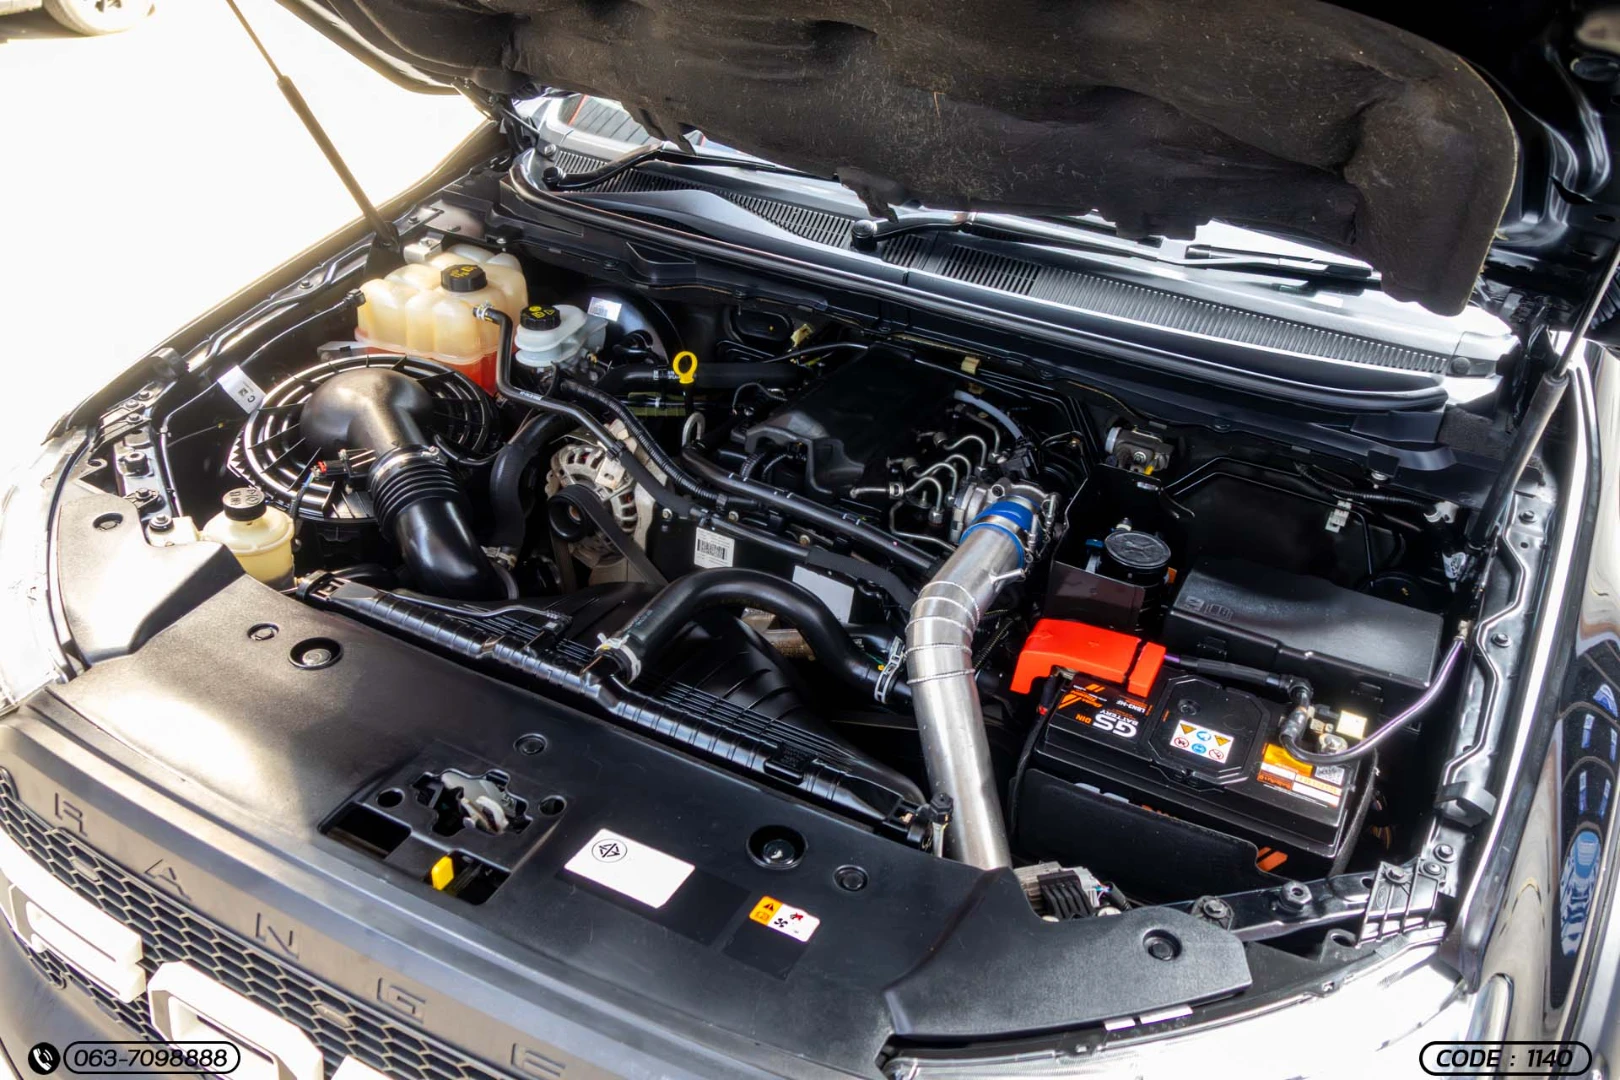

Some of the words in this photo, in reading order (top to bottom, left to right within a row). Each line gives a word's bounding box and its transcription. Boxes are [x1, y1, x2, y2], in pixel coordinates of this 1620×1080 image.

[1075, 714, 1092, 724] DIN
[1092, 713, 1138, 738] GS
[1100, 709, 1139, 726] BATTERY
